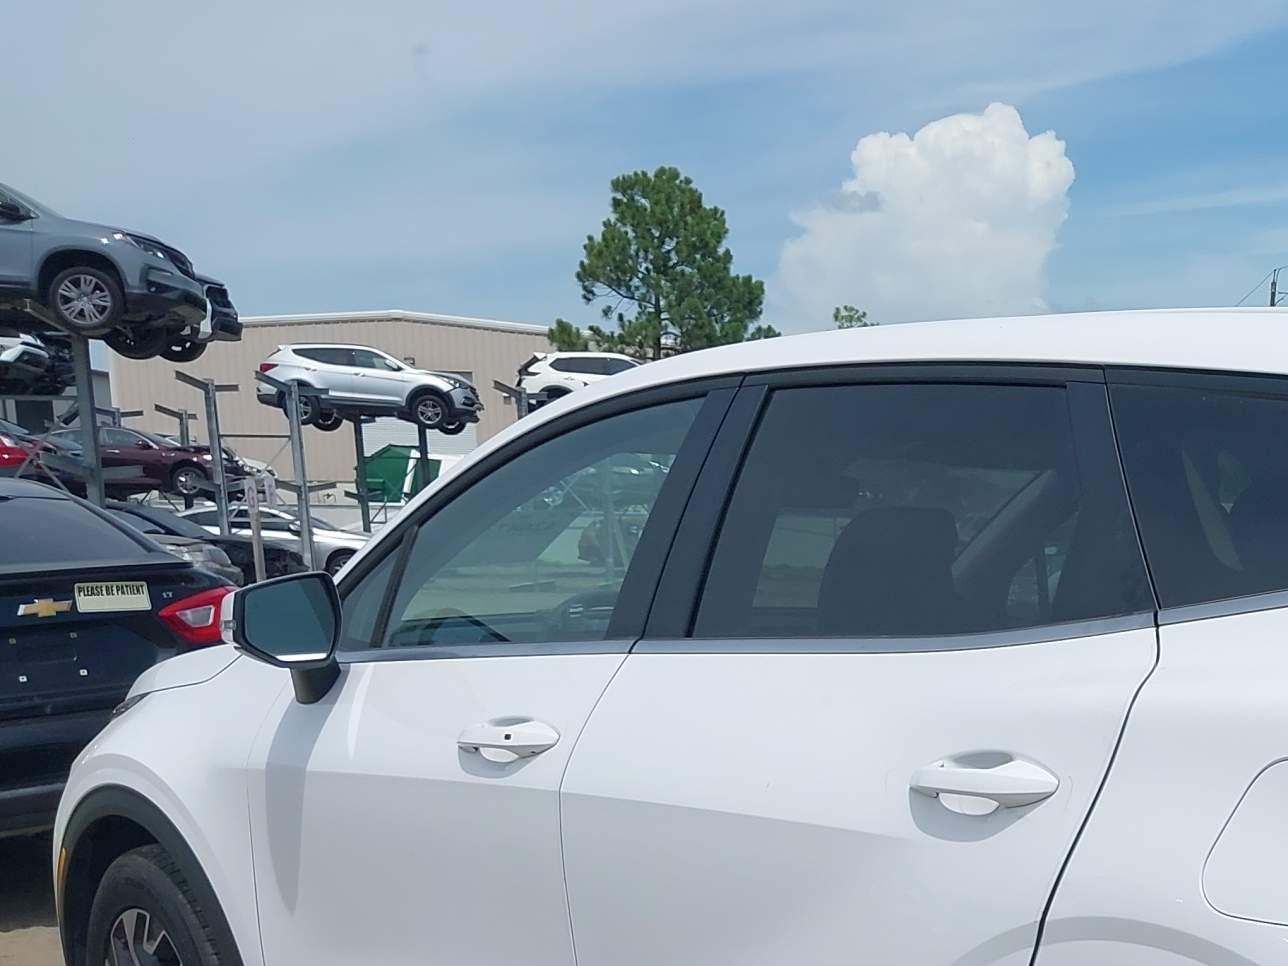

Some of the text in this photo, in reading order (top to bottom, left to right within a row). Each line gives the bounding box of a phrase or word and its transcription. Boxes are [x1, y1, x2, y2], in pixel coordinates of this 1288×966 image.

[78, 584, 145, 597] PLEASE BE PATIENT
